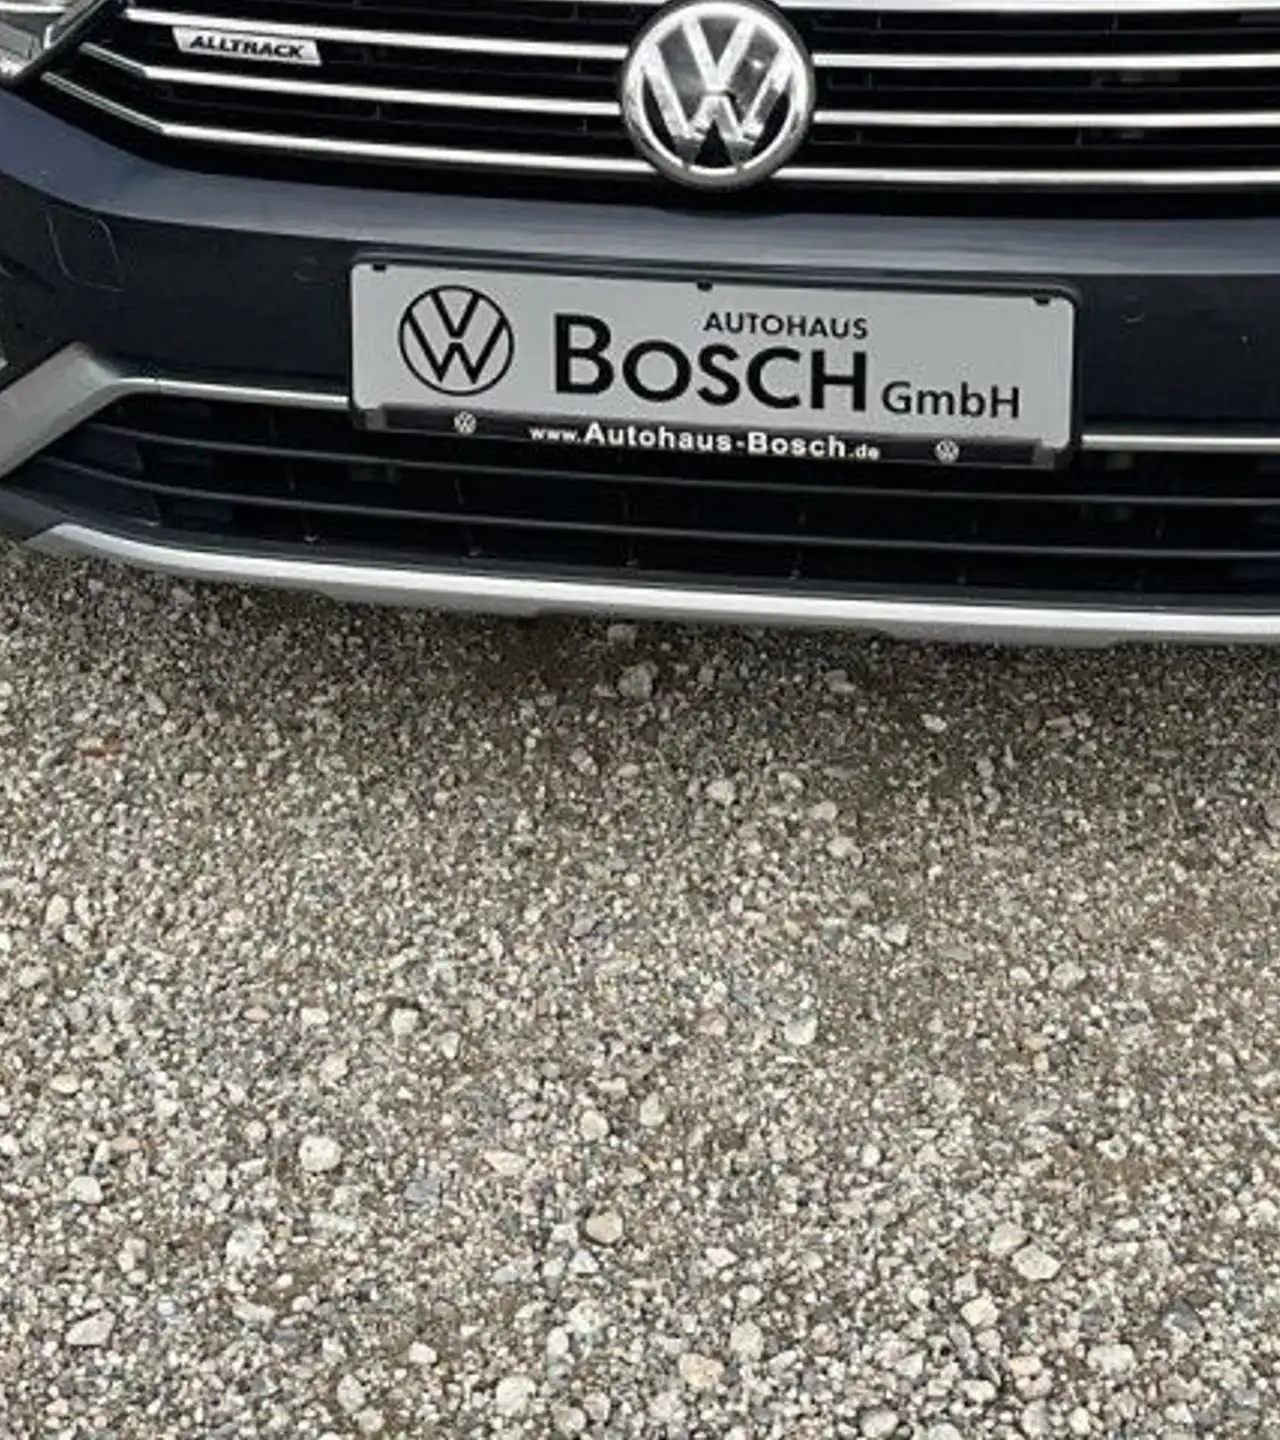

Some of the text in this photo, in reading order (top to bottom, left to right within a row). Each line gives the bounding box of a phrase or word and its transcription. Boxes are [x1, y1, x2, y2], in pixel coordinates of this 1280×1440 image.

[188, 34, 306, 59] ALLTRACK
[702, 310, 869, 341] AUTOHAUS
[553, 312, 1020, 420] BOSCH GmbH
[528, 420, 881, 461] www.Autohaus-Bosch.de
